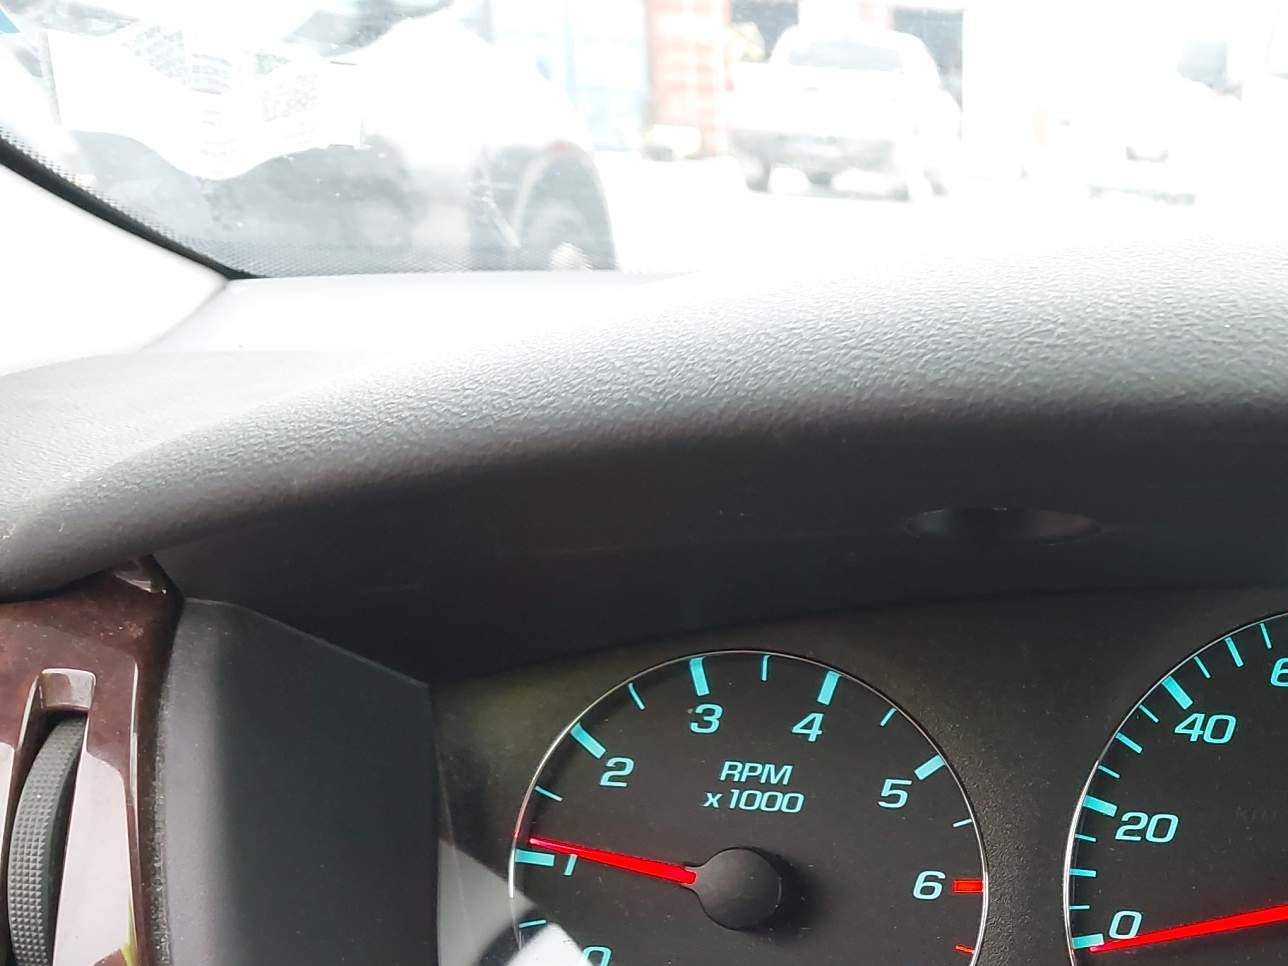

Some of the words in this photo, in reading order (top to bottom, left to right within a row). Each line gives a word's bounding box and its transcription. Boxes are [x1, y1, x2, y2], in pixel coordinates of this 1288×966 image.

[690, 703, 723, 734] 3
[791, 712, 824, 742] 4
[1174, 713, 1236, 744] 40
[600, 757, 634, 788] 2
[719, 760, 793, 785] RPM
[878, 778, 912, 809] 5
[1114, 812, 1179, 843] 20
[912, 870, 946, 901] 6
[1108, 910, 1142, 940] 0
